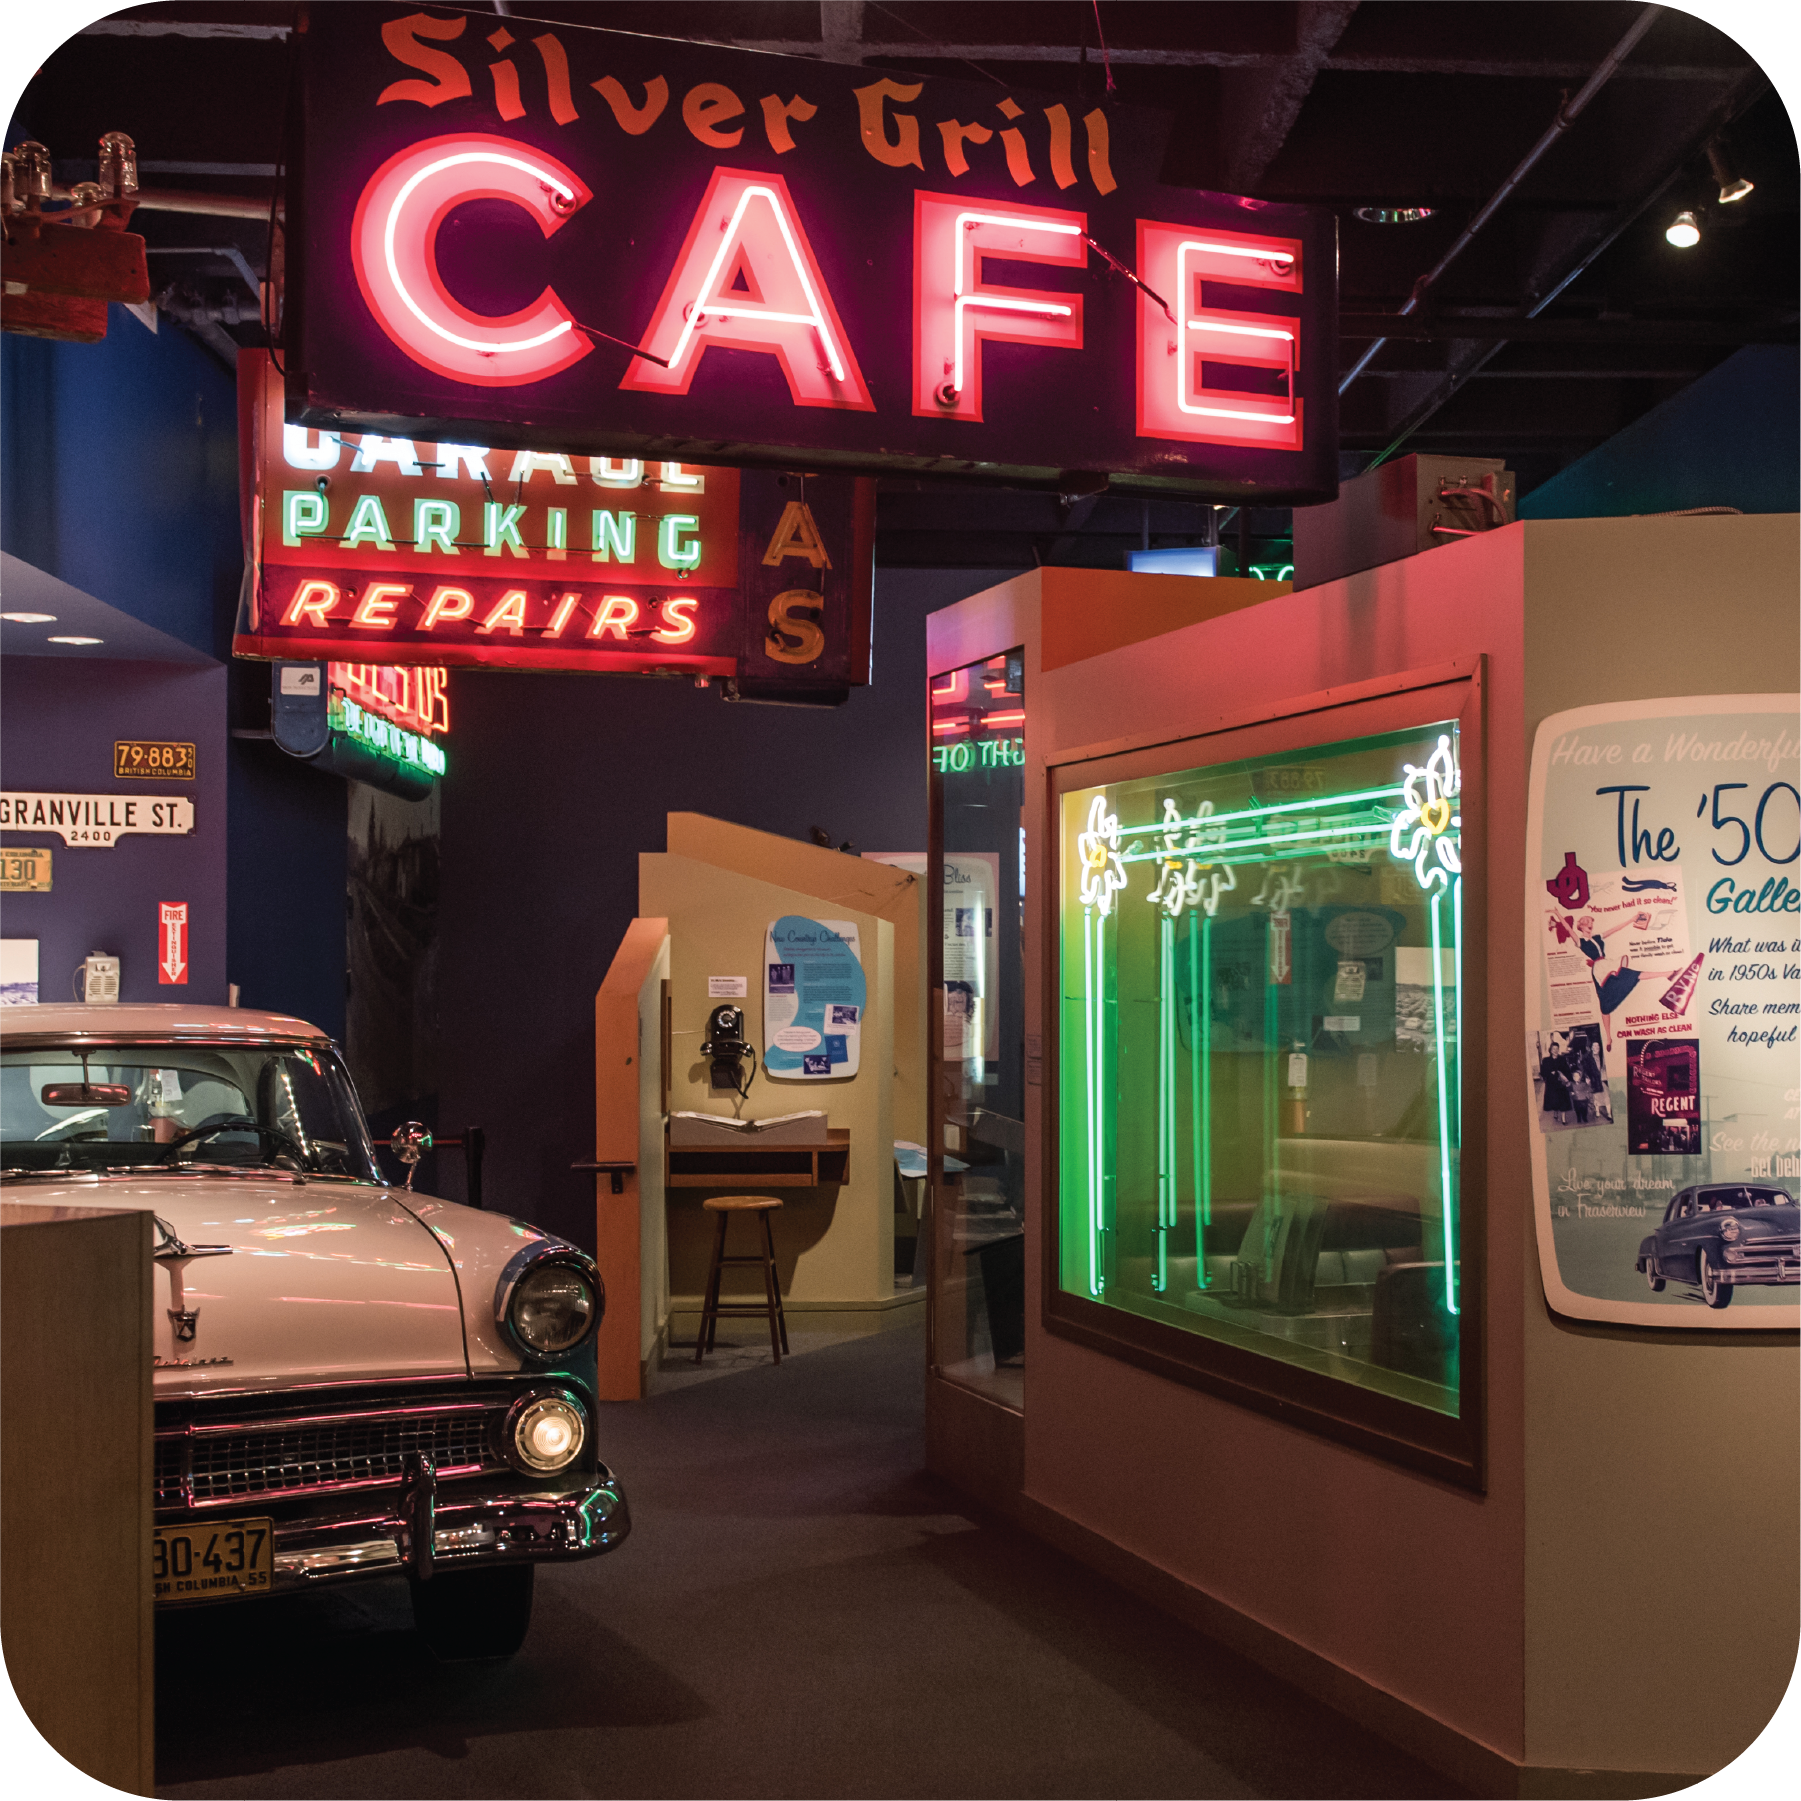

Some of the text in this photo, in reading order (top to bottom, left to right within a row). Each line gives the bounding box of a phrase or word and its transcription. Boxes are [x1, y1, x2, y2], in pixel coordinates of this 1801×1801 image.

[377, 12, 1118, 196] Silver Grill
[350, 132, 1304, 451] CAFE
[282, 490, 702, 571] PARKING
[761, 471, 833, 665] AS
[279, 580, 699, 645] REPAIRS
[1551, 735, 1623, 766] Have
[1632, 741, 1653, 763] a
[118, 767, 192, 776] BRITISH COLUMBIA
[0, 799, 182, 828] GRANVILLE ST.
[71, 831, 111, 841] 2400
[1596, 785, 1680, 867] The
[943, 864, 971, 885] Bliss
[1603, 904, 1621, 912] never
[1622, 898, 1635, 908] had
[1706, 876, 1801, 914] Galle
[164, 910, 184, 921] FIRE
[1708, 936, 1751, 954] What
[1754, 940, 1787, 953] was
[1708, 963, 1801, 981] in 1950s Va
[1625, 1011, 1679, 1024] NOTHING ELSE
[1708, 998, 1801, 1016] Share mem
[1617, 1024, 1692, 1038] CAN WASH AS CLEAN
[1727, 1025, 1798, 1050] hopeful
[1651, 1095, 1696, 1118] REGENT
[1708, 1130, 1801, 1152] See the n
[1751, 1156, 1772, 1178] Get
[1557, 1167, 1675, 1197] Live your dream
[1557, 1193, 1646, 1219] in Fraserview
[177, 1575, 239, 1592] COLUMBIA
[248, 1571, 267, 1586] 55
